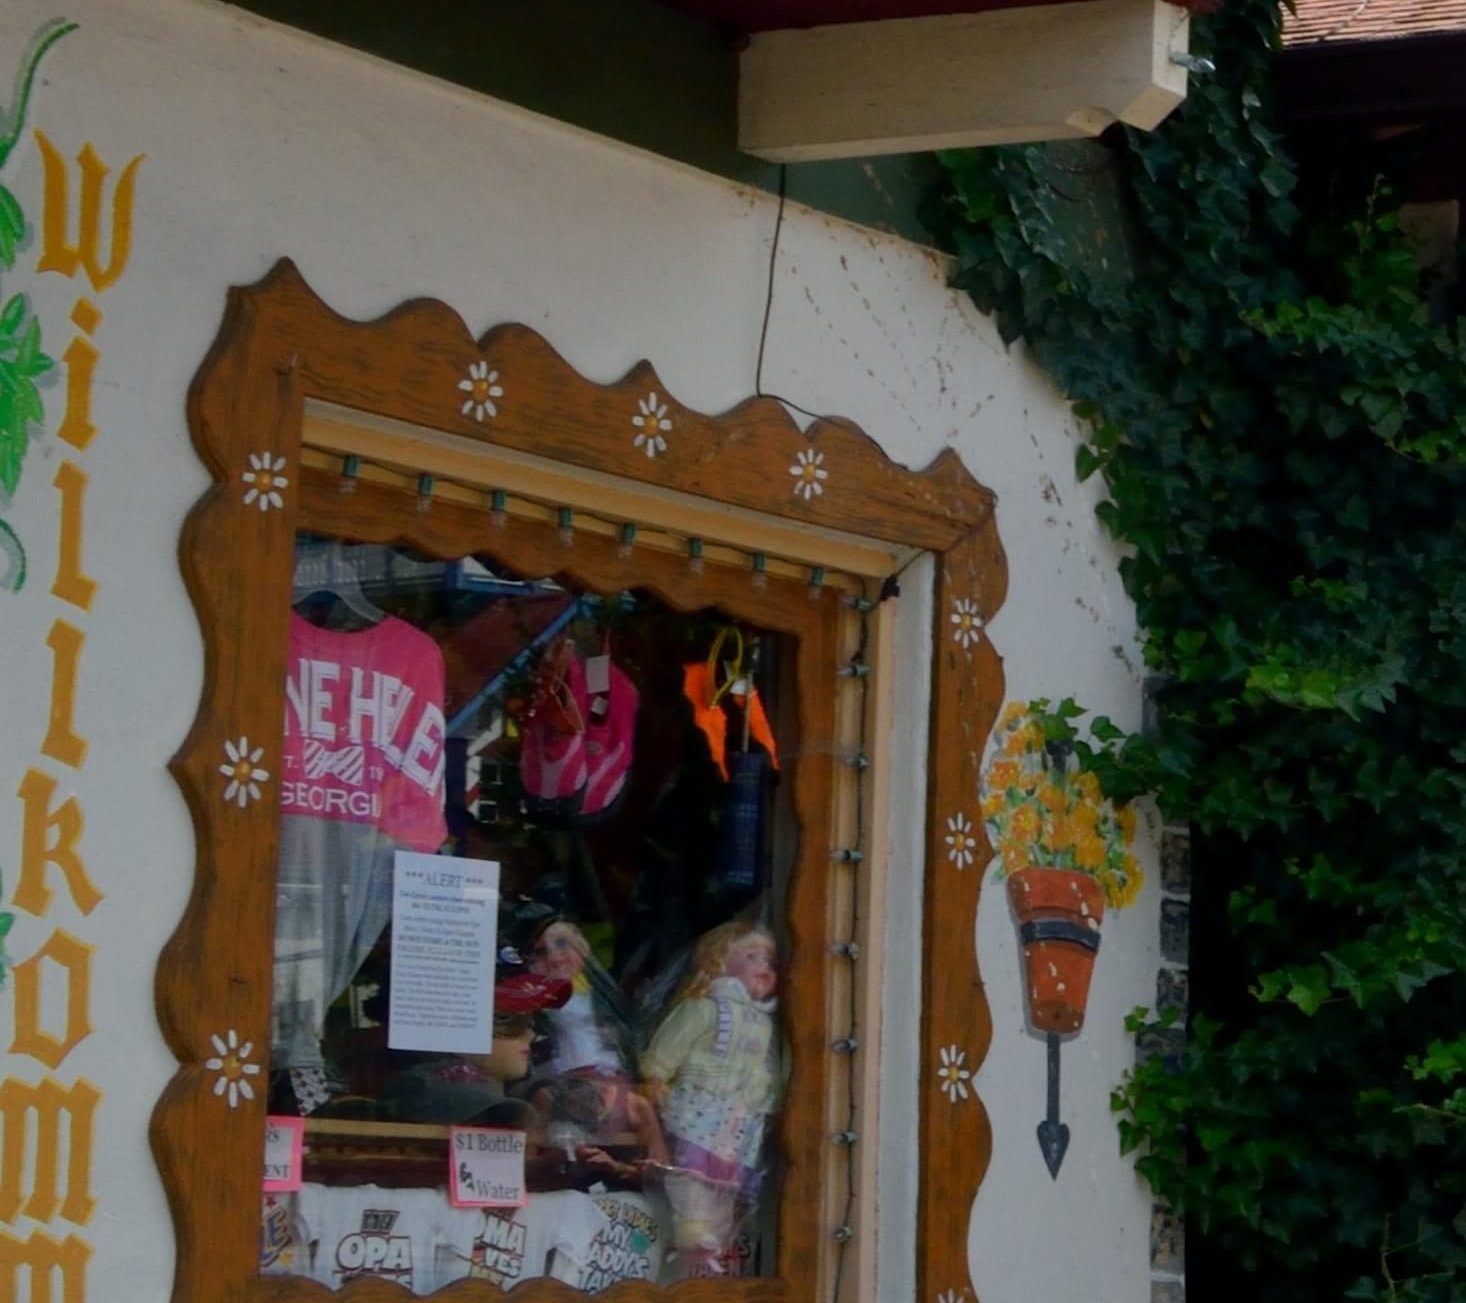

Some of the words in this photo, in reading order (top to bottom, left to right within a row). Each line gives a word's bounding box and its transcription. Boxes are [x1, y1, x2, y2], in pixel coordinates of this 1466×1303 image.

[455, 1131, 473, 1151] $1
[477, 1132, 524, 1155] Bottle
[476, 1178, 521, 1201] Water
[335, 1232, 413, 1273] OPA
